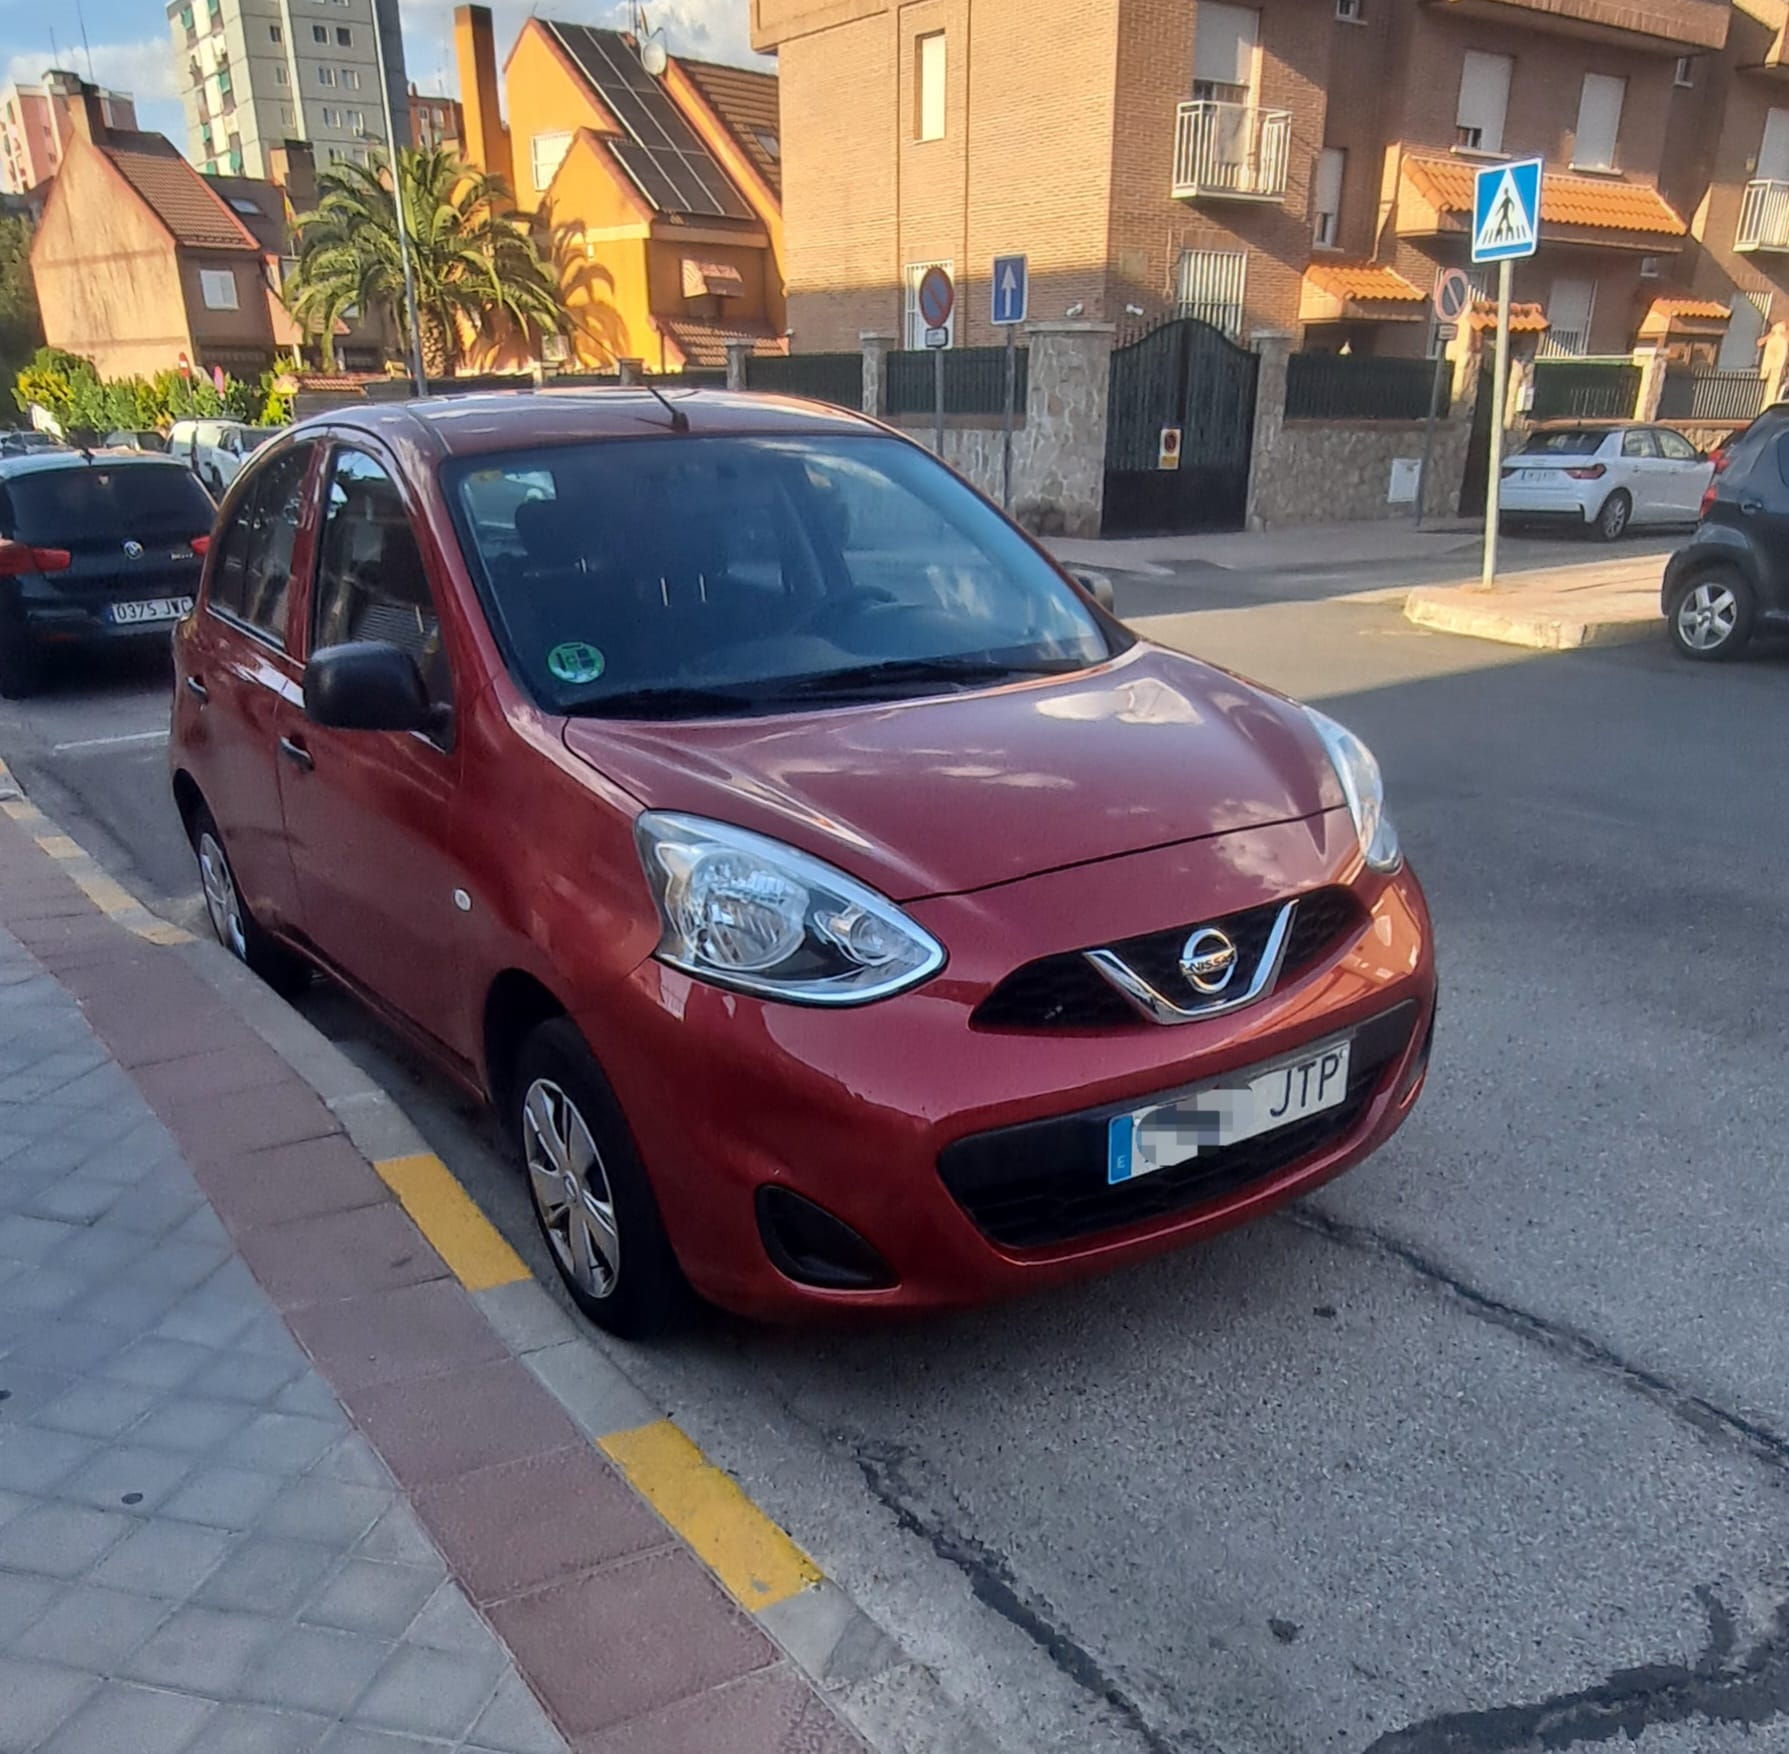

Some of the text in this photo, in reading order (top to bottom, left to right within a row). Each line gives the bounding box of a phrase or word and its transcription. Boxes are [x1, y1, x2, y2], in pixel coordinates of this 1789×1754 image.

[116, 602, 157, 620] 0375
[1116, 1055, 1339, 1169] E JTP
